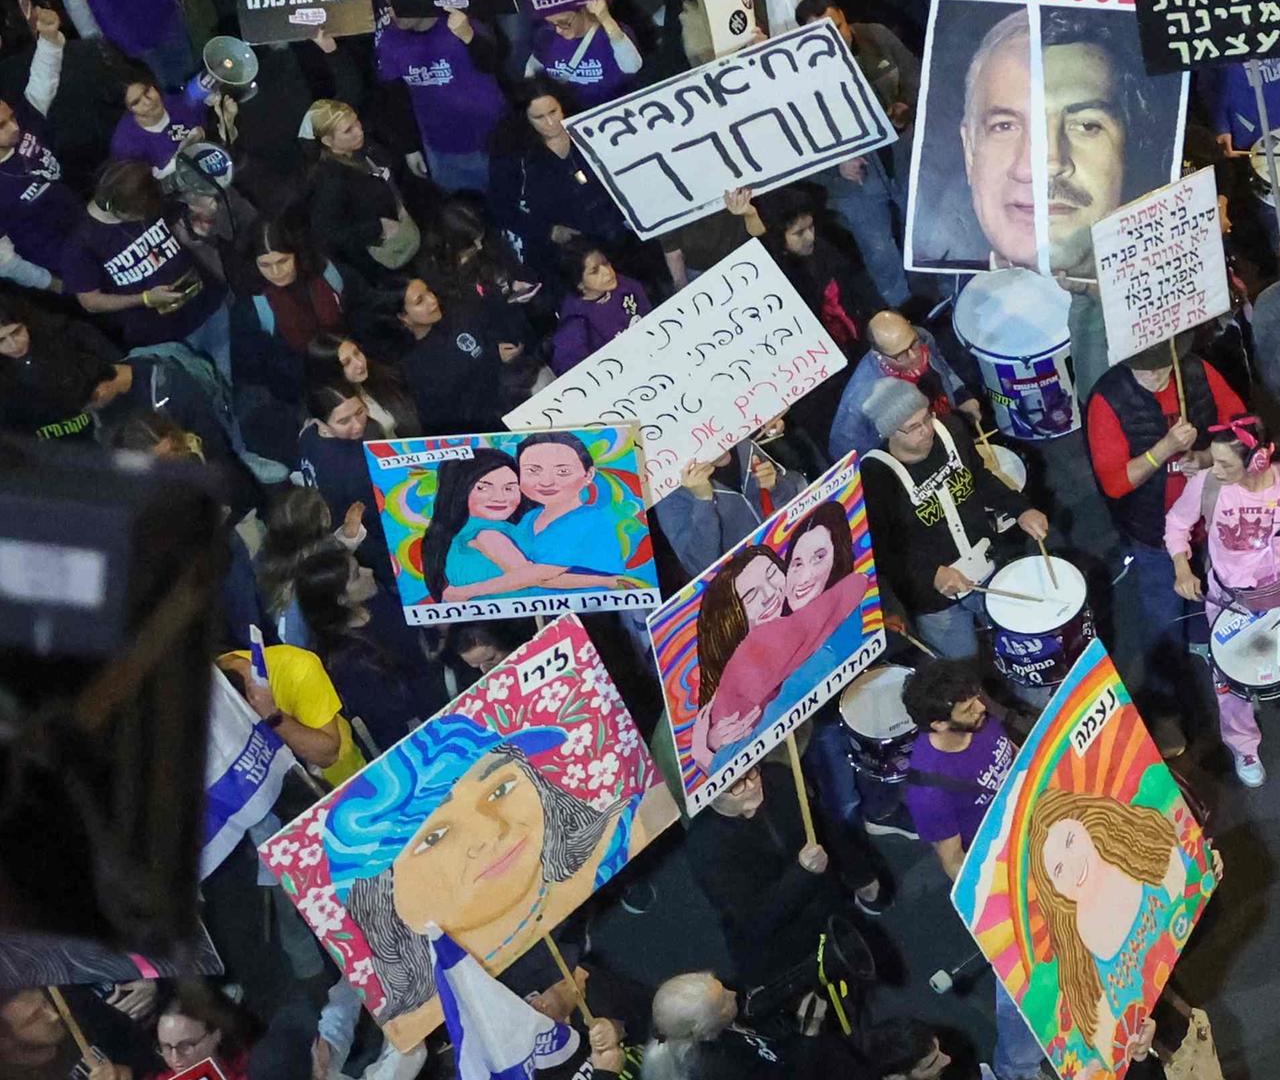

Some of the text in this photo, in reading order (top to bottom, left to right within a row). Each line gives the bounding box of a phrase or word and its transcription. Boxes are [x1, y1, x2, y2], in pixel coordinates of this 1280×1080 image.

[1173, 184, 1194, 207] לא
[1126, 216, 1165, 241] ארצי
[1143, 232, 1165, 252] את
[1100, 244, 1138, 271] פניה
[1186, 290, 1207, 306] עד
[1186, 305, 1208, 325] את
[382, 448, 470, 467] קרינה ואירה
[411, 591, 656, 623] החזירו אותה הביתה!
[689, 634, 885, 811] החזירו אותה הביתה!
[1077, 688, 1117, 750] נעמה
